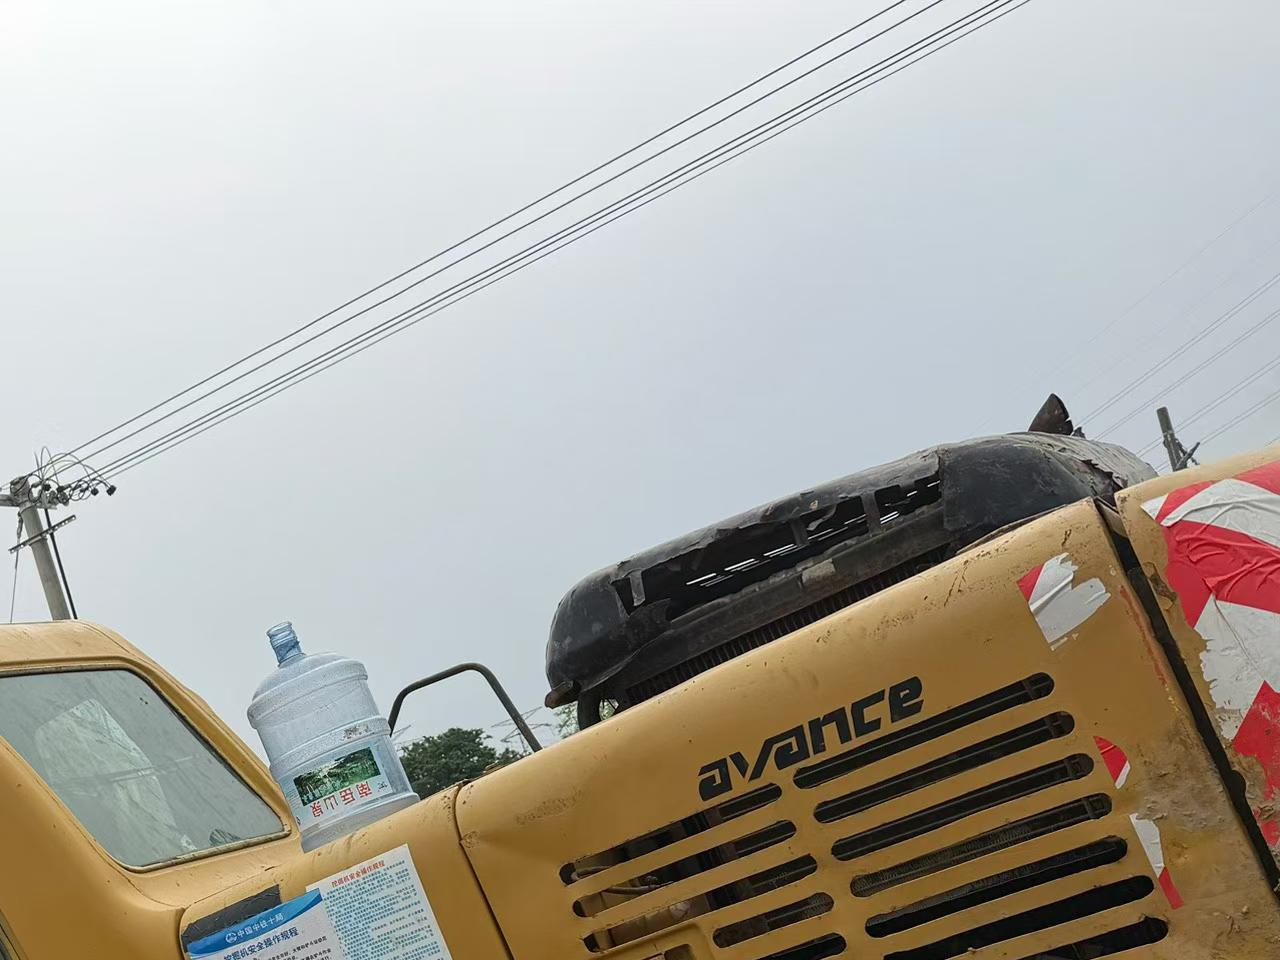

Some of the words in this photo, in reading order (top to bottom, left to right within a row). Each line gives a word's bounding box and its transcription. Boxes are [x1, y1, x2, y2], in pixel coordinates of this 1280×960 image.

[698, 676, 924, 801] avance
[311, 781, 372, 817] 南岳山泉
[236, 912, 284, 937] 中国中铁十局
